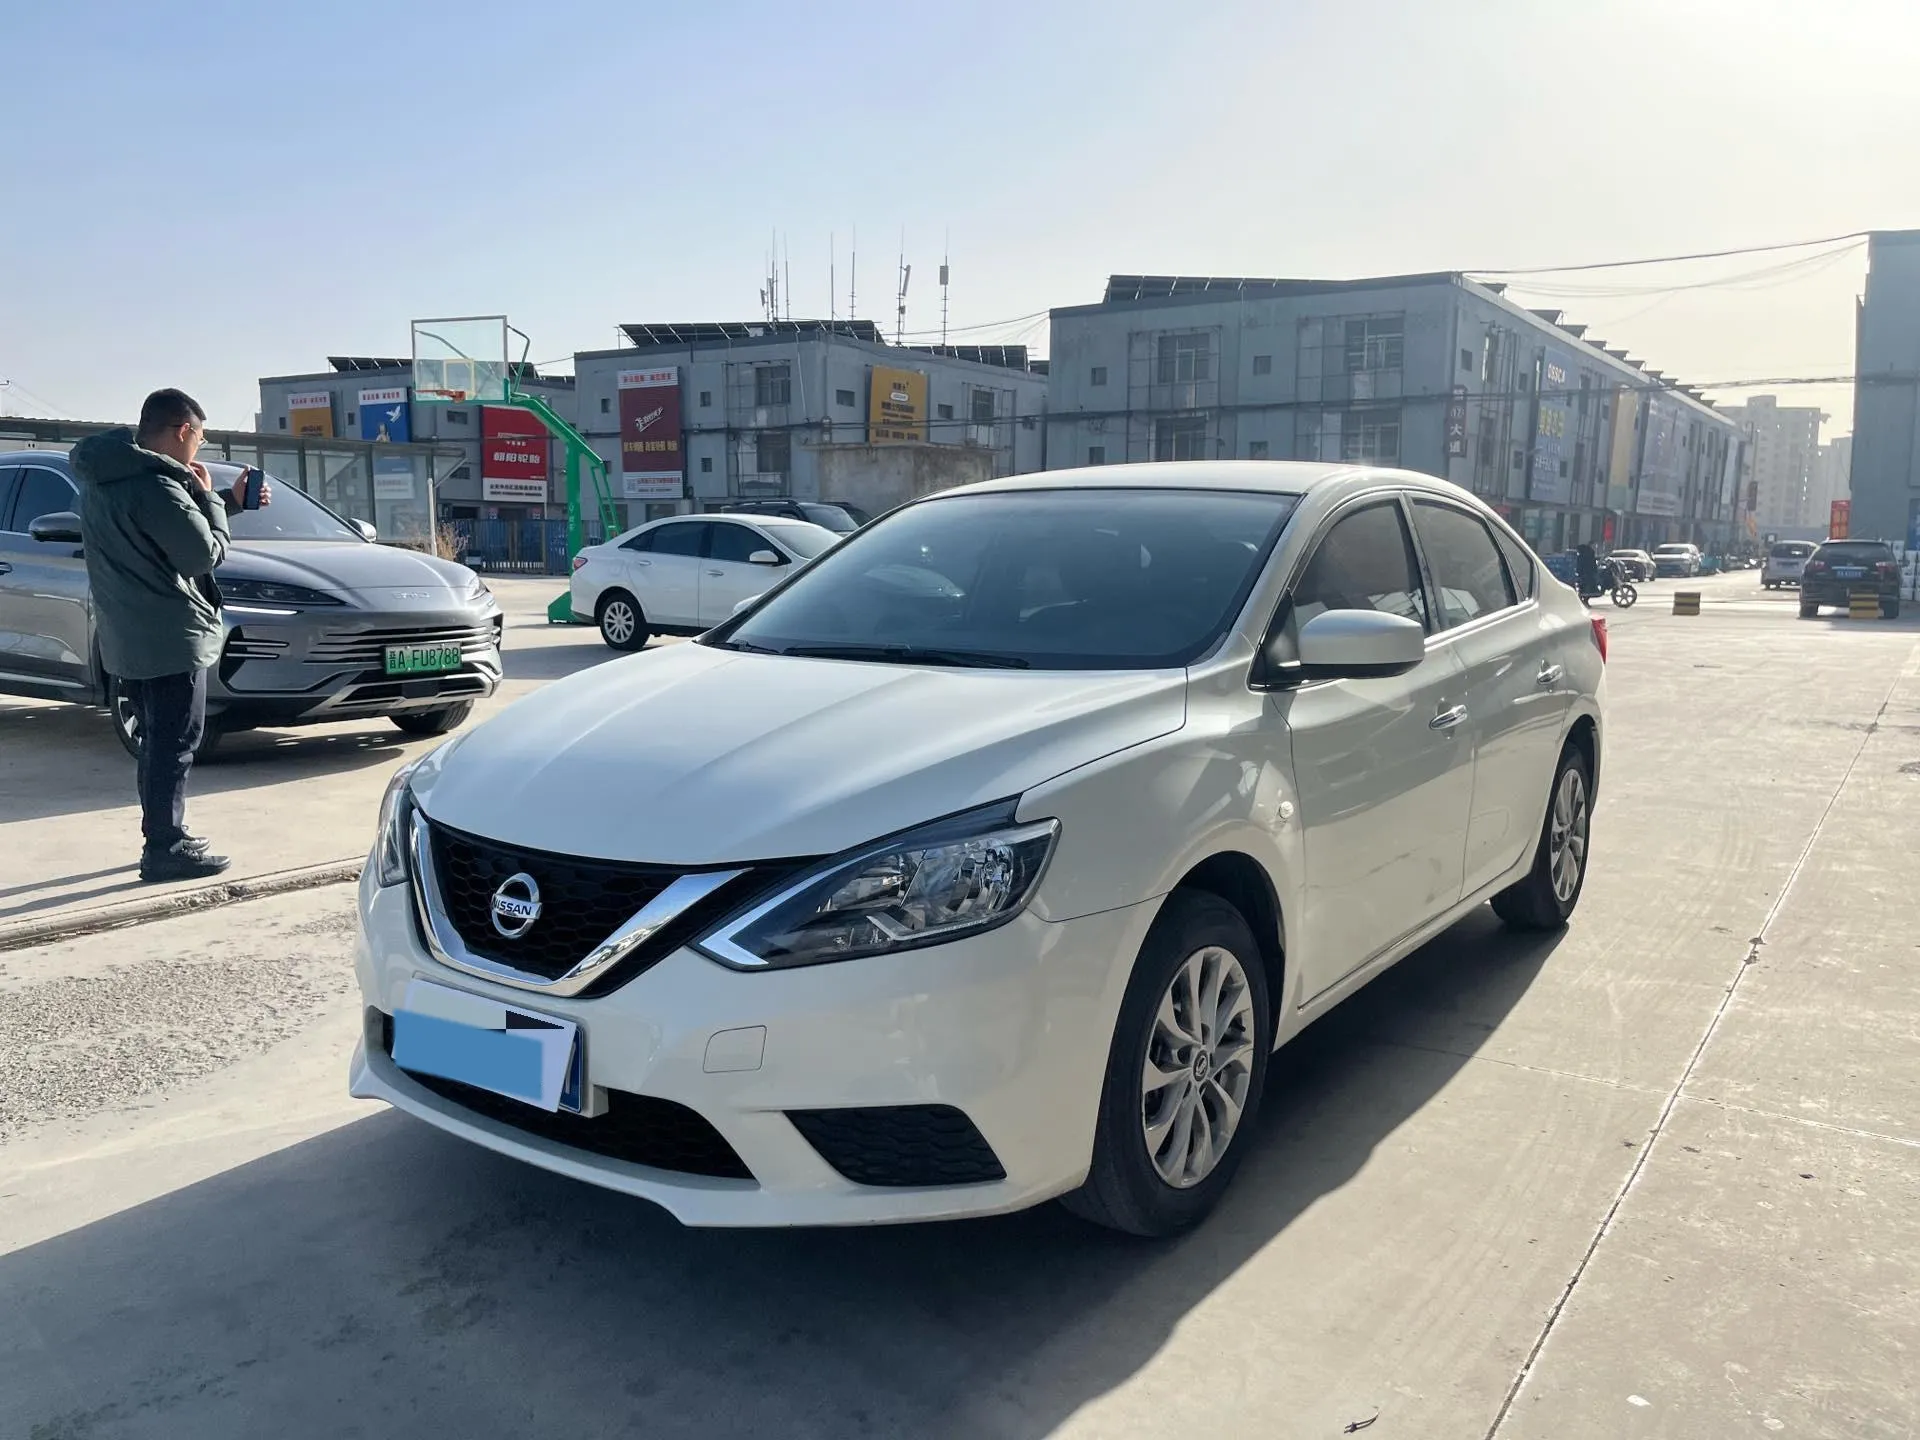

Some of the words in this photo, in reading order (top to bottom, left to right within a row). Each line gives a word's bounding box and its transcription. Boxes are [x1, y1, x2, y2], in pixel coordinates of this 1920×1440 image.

[493, 452, 541, 464] 朝阳轮胎
[492, 896, 532, 916] NISSAN
